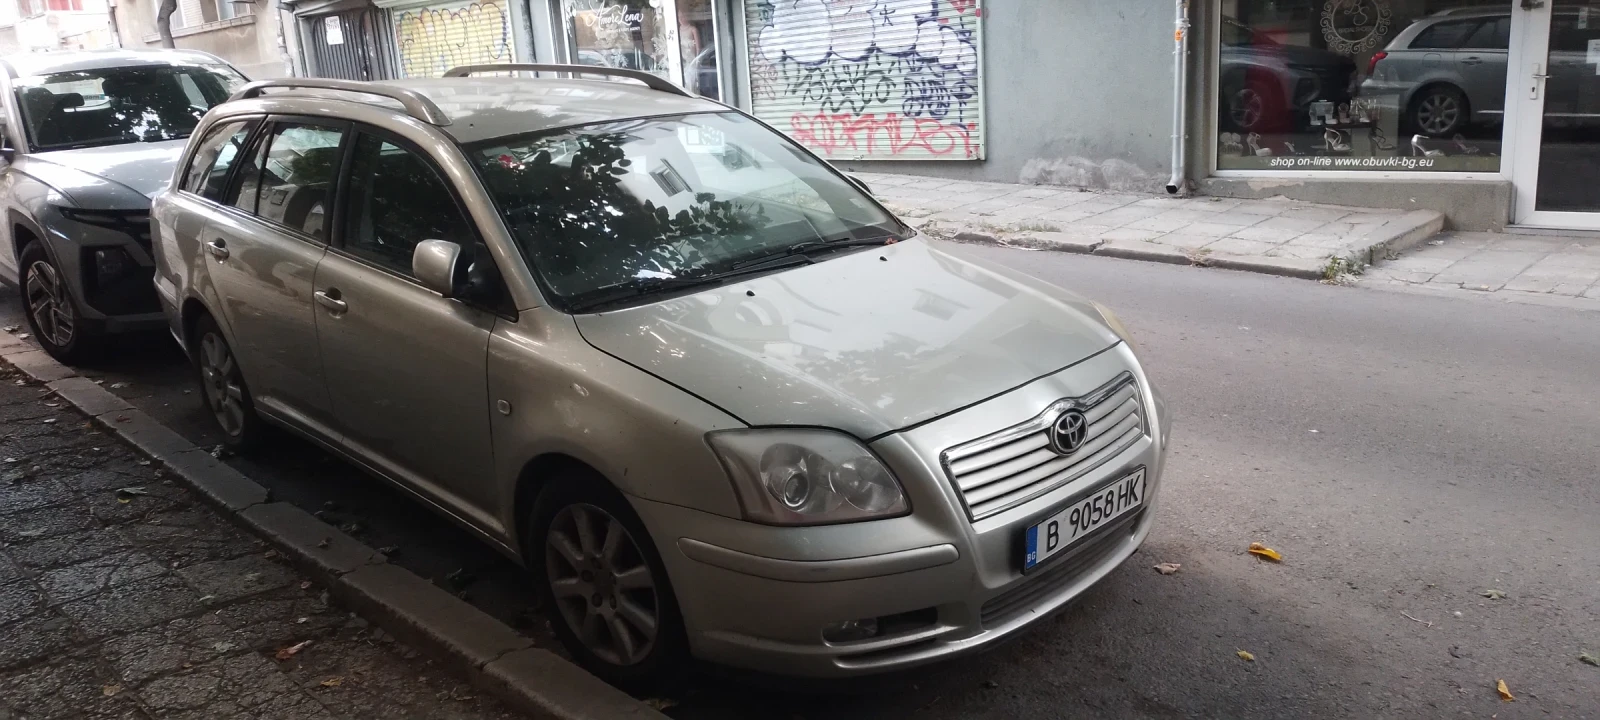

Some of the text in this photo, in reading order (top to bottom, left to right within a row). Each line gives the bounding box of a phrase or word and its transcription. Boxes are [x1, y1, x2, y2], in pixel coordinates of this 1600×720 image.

[1270, 156, 1434, 168] shop on-line www.obuvki-bg.eu
[1046, 474, 1141, 553] B 9058 HK
[1027, 551, 1036, 563] BG
